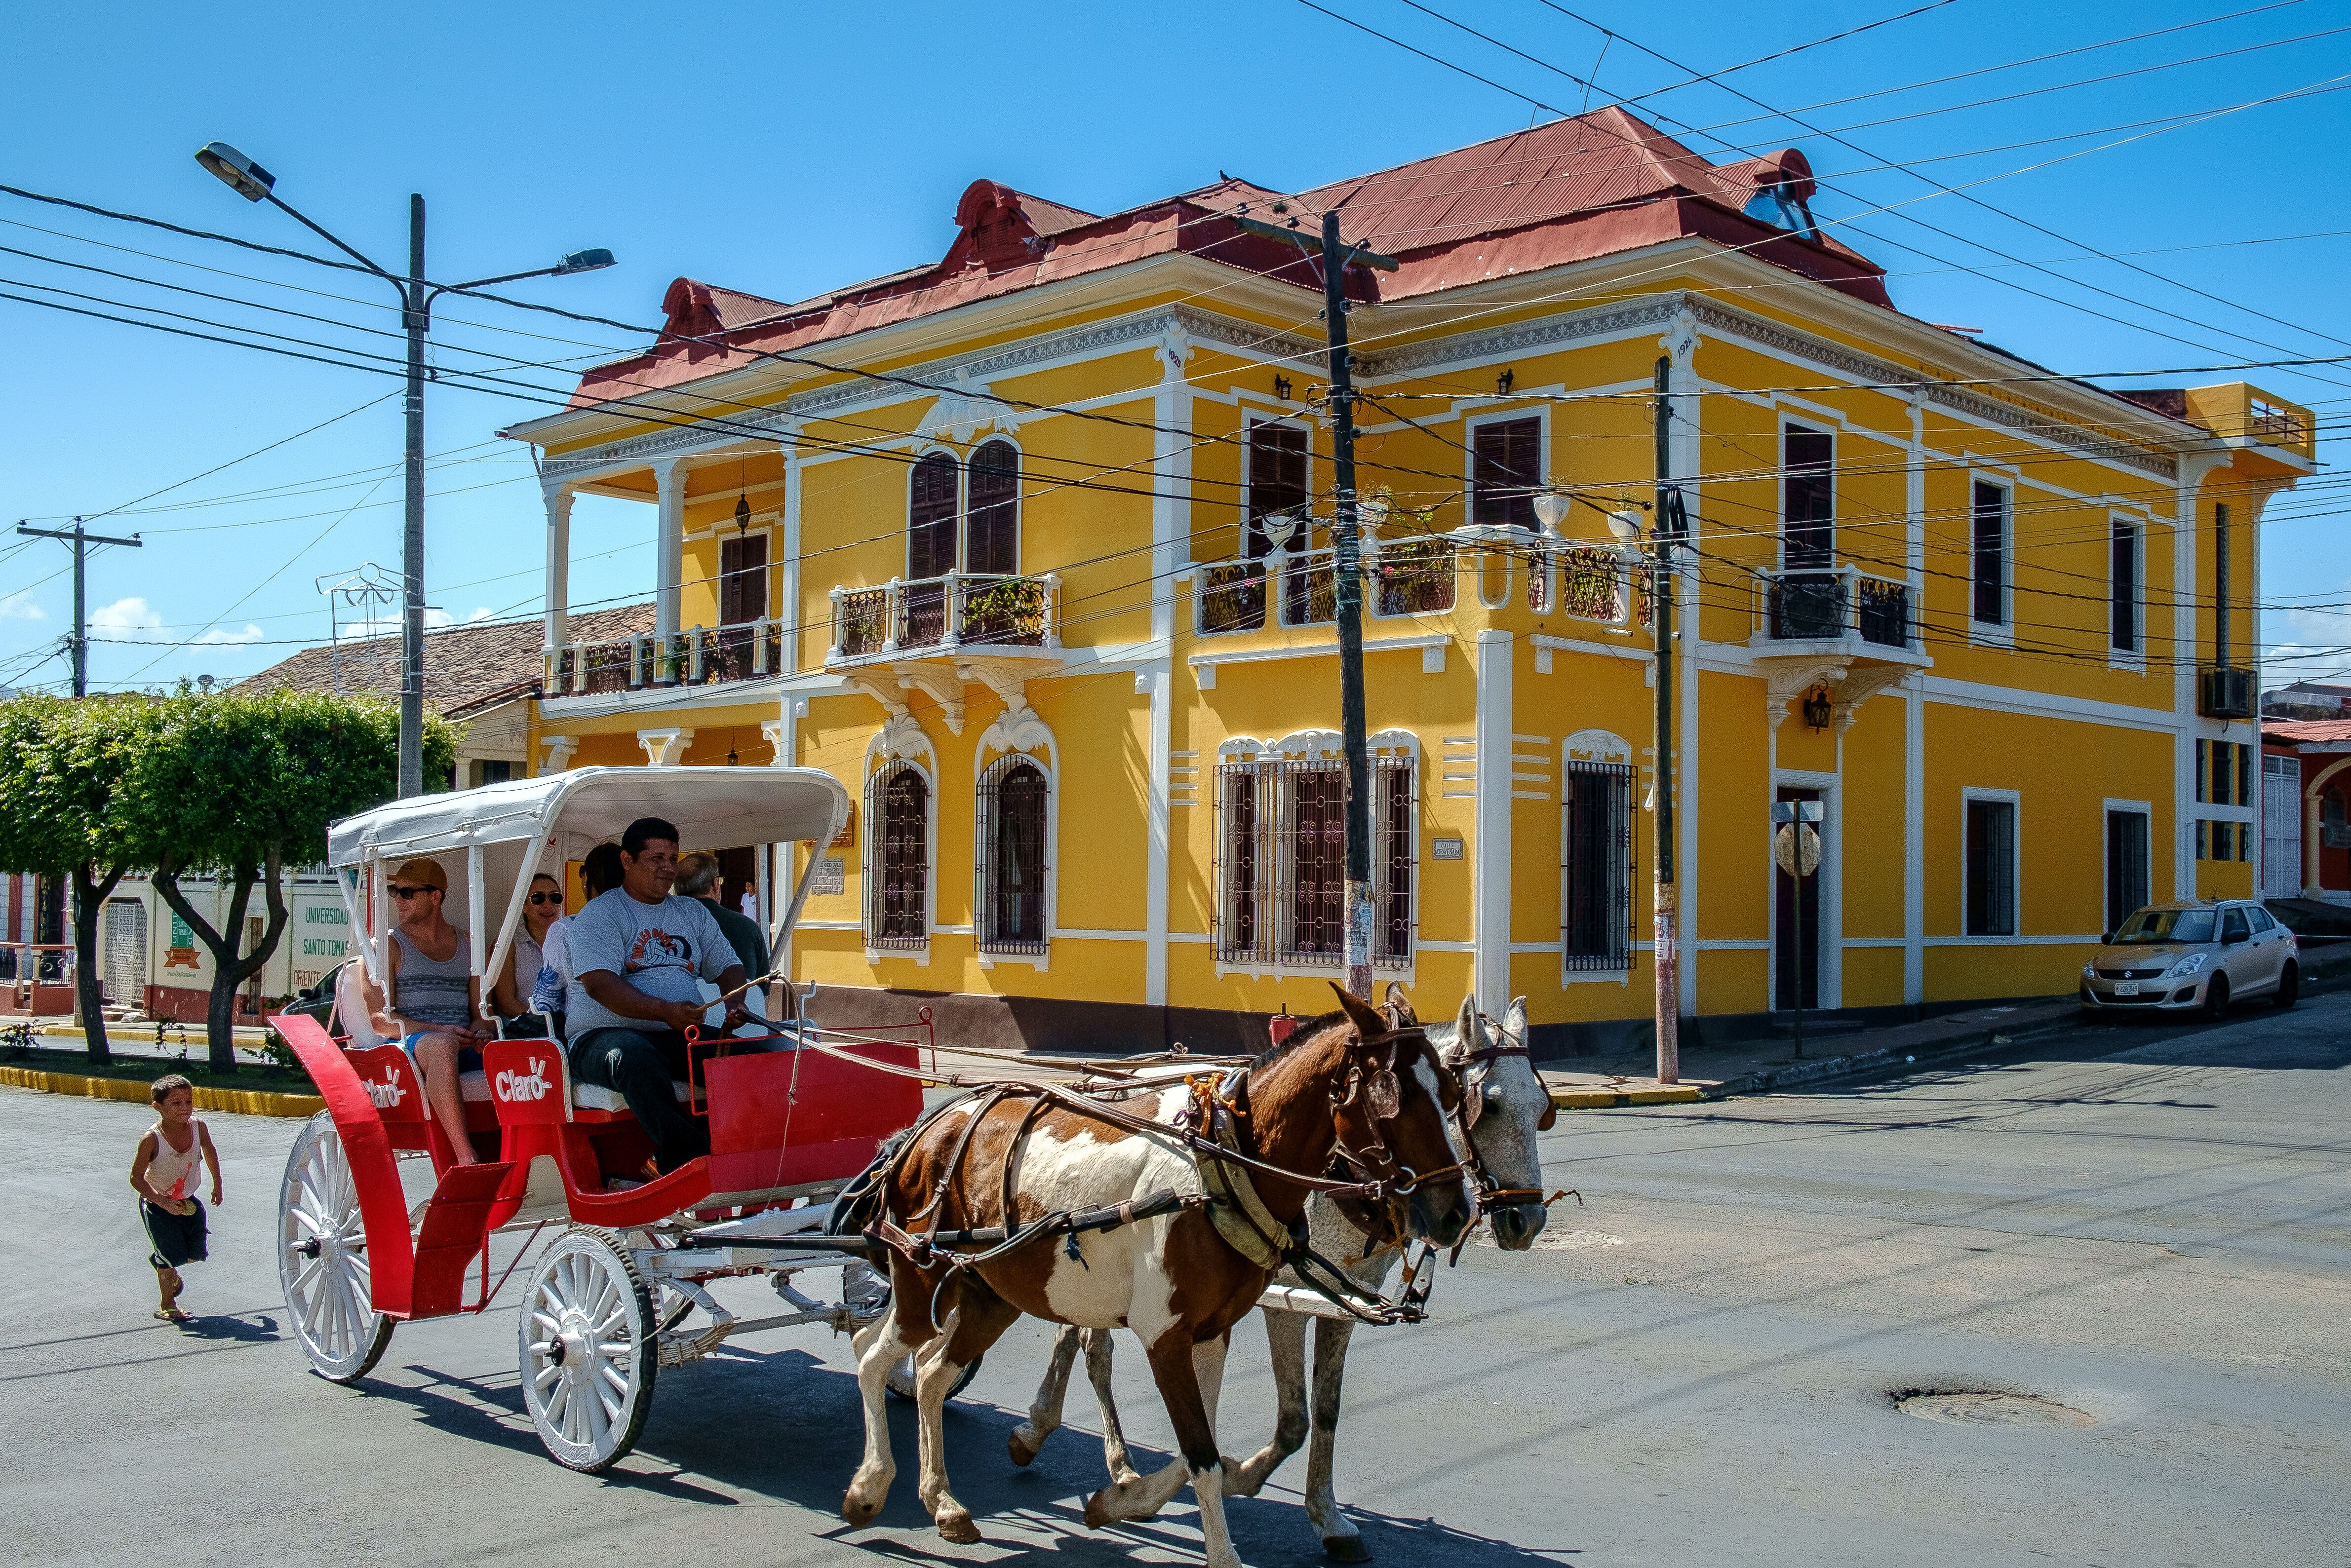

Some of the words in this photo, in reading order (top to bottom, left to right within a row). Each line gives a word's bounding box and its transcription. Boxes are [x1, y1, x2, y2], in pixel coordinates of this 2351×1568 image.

[306, 907, 349, 925] UNIVERSIDAD
[303, 939, 325, 956] SANTO
[496, 1069, 546, 1102] Claro
